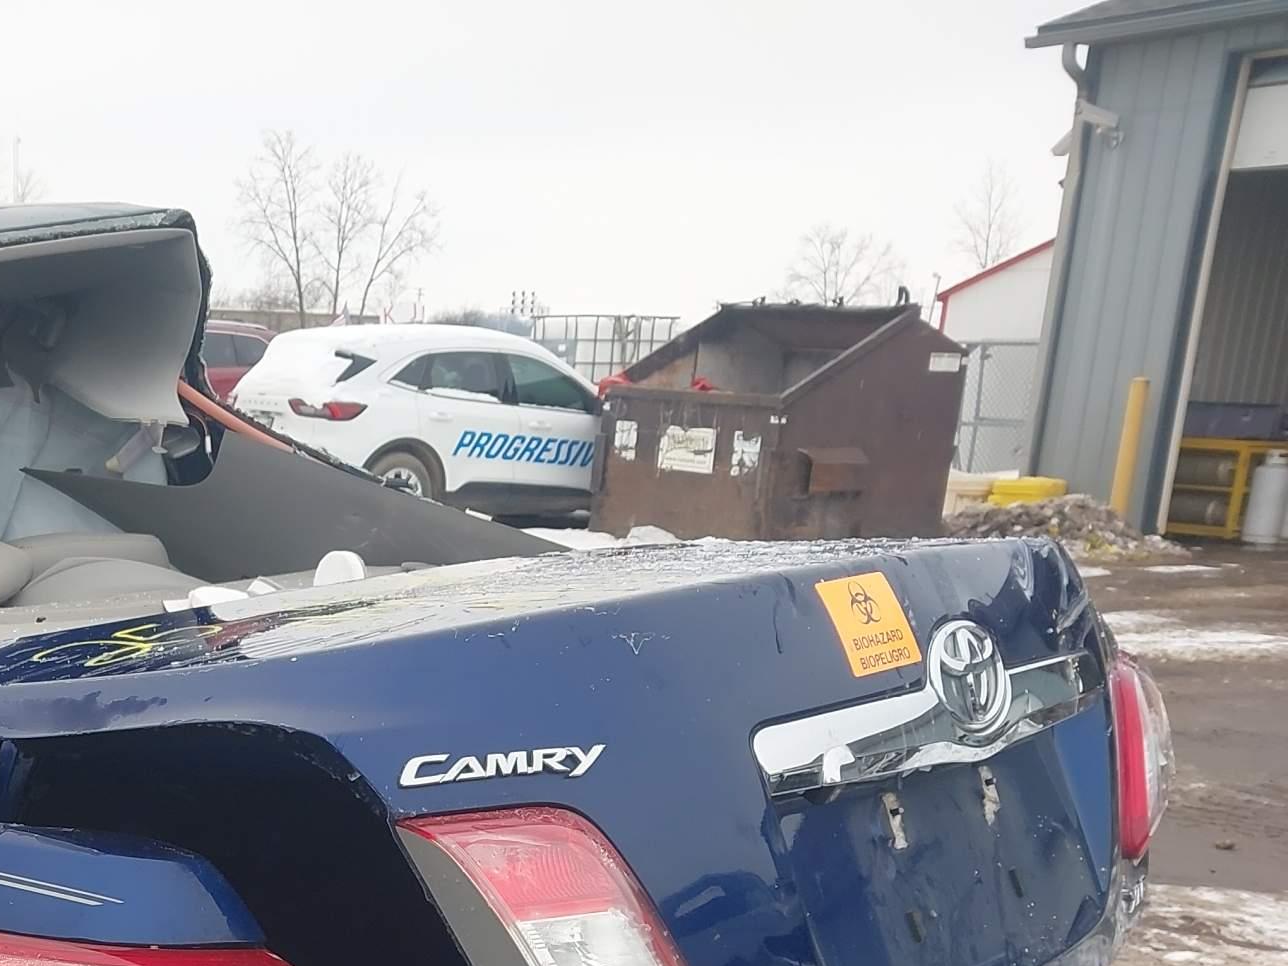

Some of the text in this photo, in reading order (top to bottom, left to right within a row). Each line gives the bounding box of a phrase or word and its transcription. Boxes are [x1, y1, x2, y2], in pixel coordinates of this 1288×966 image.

[853, 629, 903, 651] BIOHAZARD
[860, 647, 911, 670] BIOPELIGRO
[399, 744, 606, 788] CAMRY
